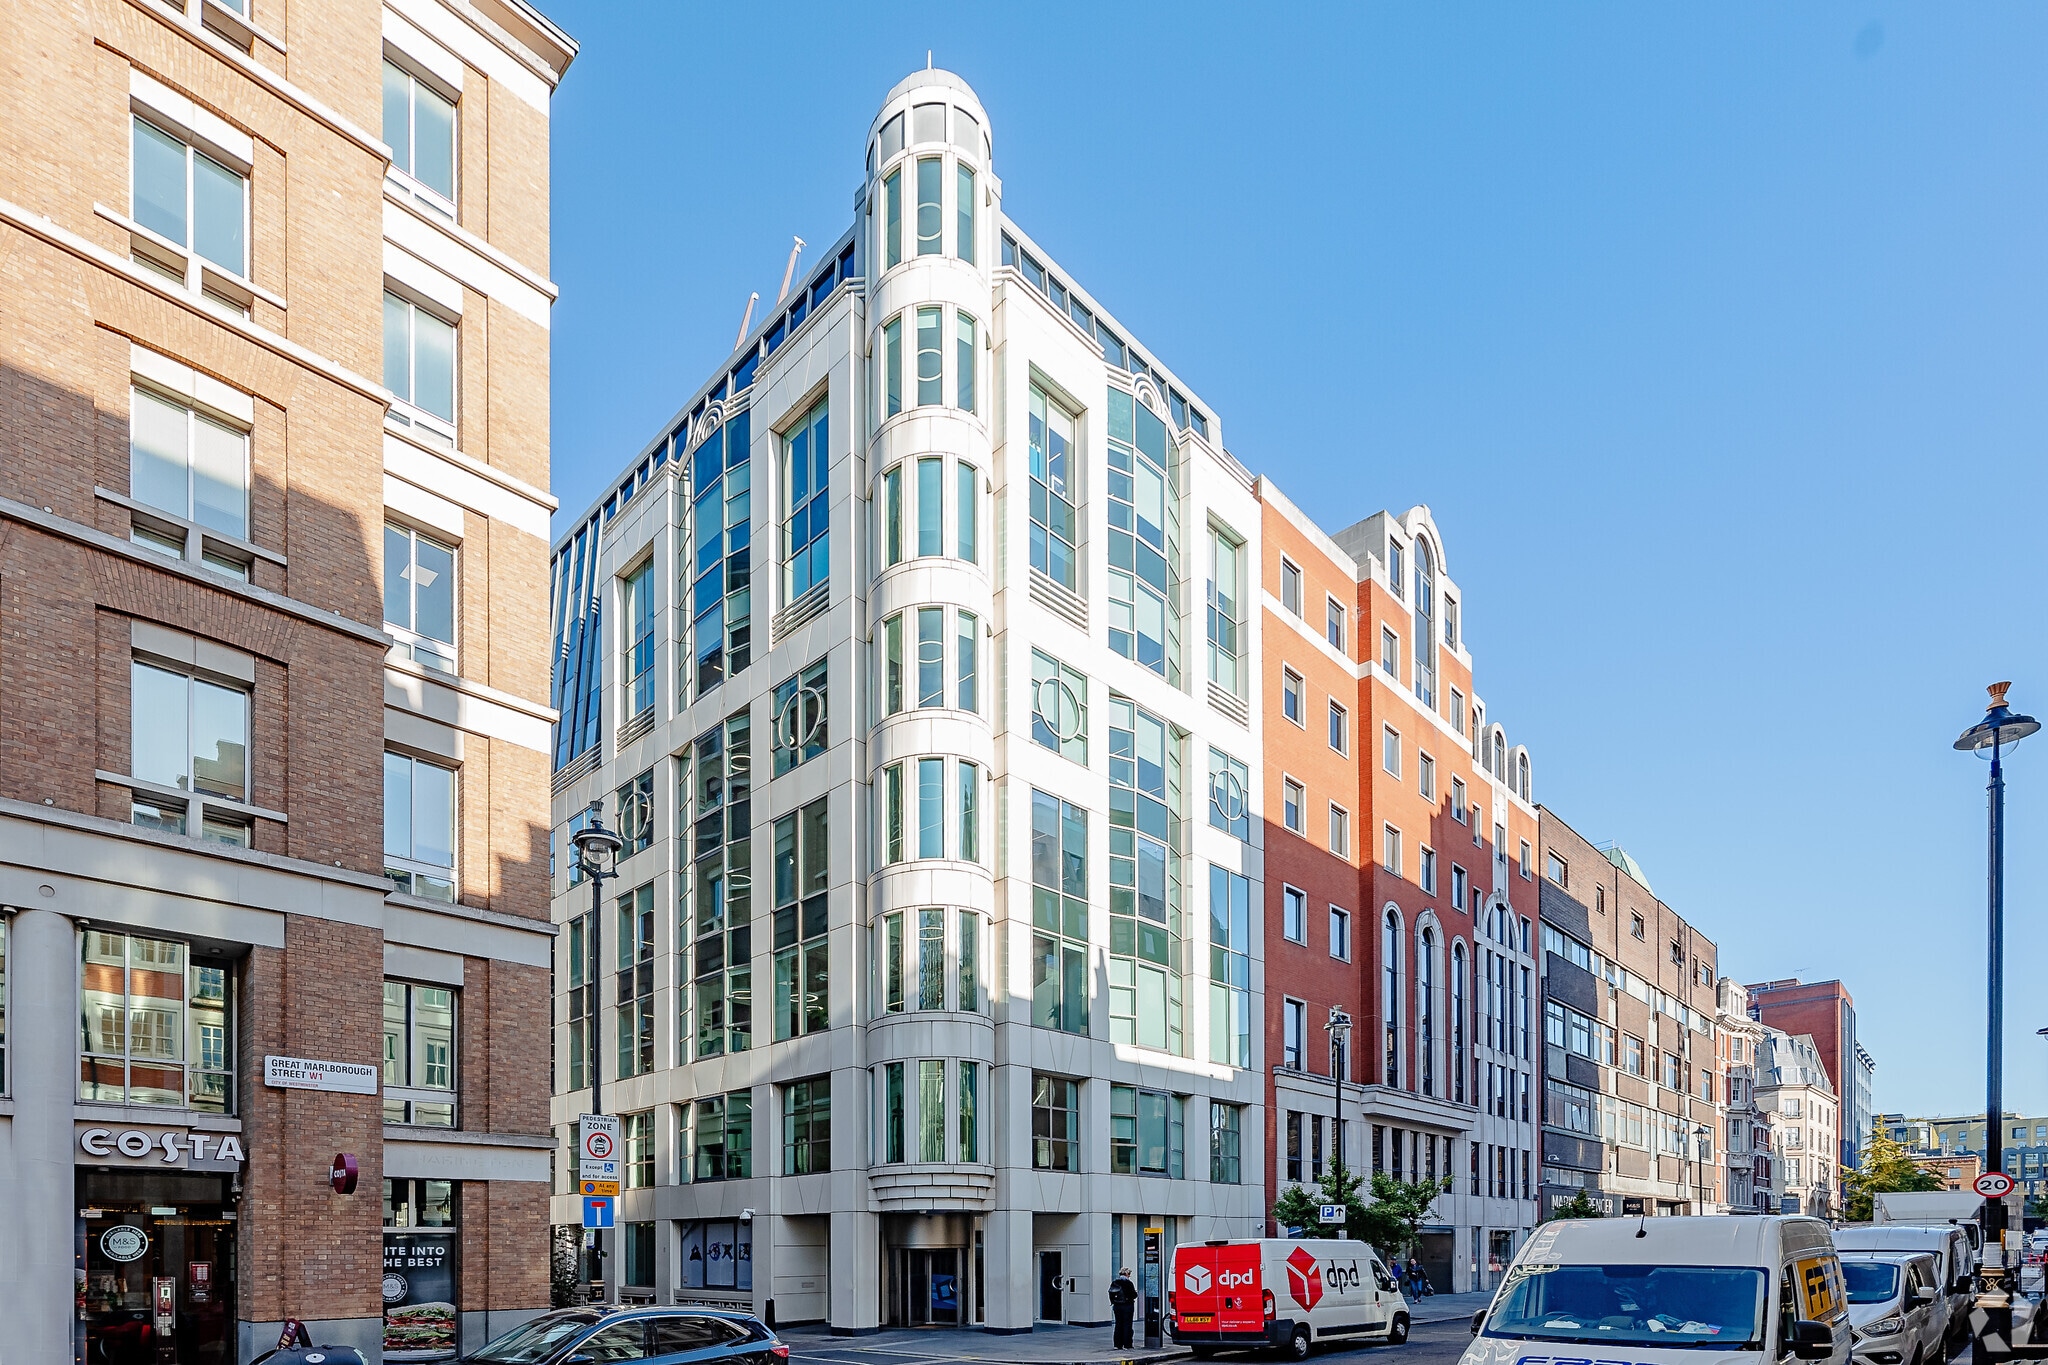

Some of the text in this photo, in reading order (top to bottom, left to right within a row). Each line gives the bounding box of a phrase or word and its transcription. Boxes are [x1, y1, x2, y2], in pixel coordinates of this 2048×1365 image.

[271, 1059, 373, 1076] GREAT MARLBOROUGH
[271, 1068, 323, 1081] STREET W1
[582, 1115, 618, 1123] PEDESTRIAN
[587, 1122, 612, 1131] ZONE
[80, 1128, 245, 1163] COSTA
[333, 1169, 346, 1178] COSTA
[1979, 1179, 2008, 1191] 20
[106, 1227, 143, 1239] AVAILABLE HERE
[106, 1249, 132, 1260] AVAILABLE
[384, 1246, 445, 1256] ITE INTO
[383, 1257, 442, 1267] HE BEST
[1218, 1268, 1253, 1289] dpd
[1326, 1260, 1360, 1294] dpd
